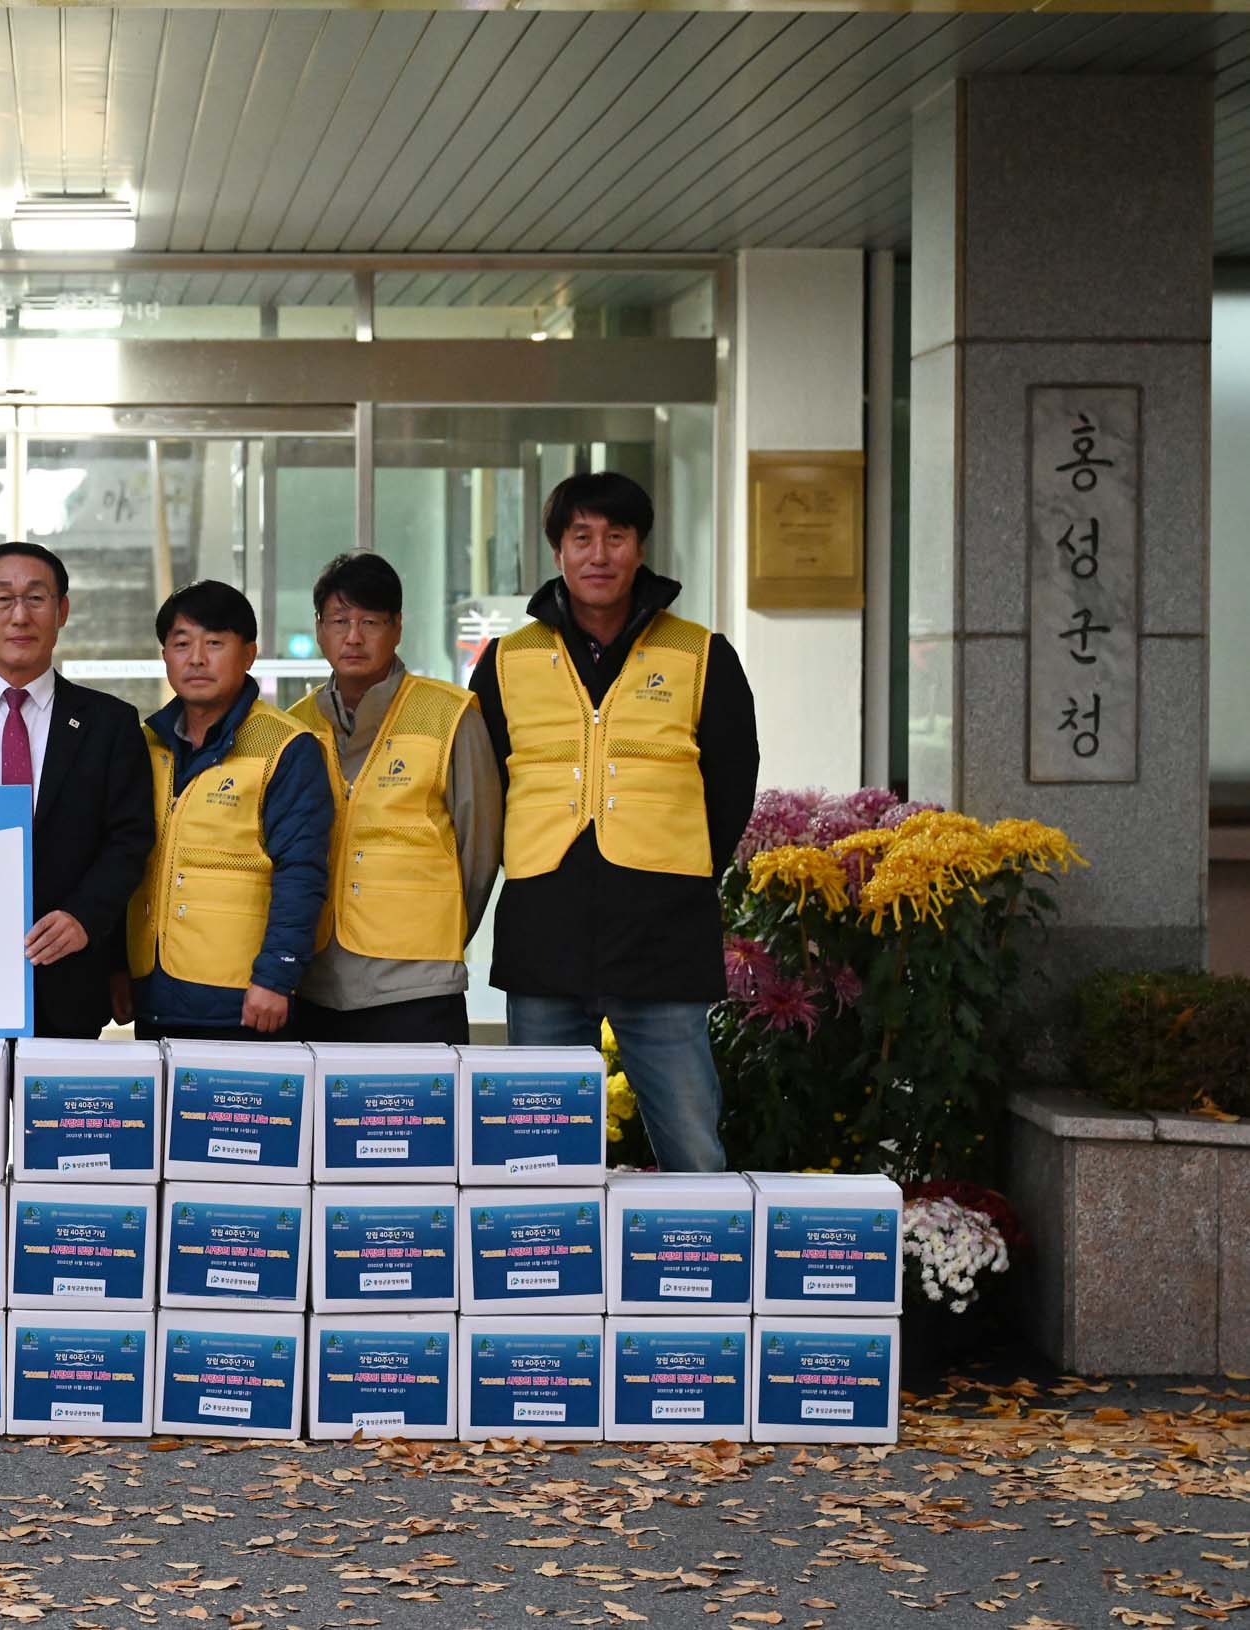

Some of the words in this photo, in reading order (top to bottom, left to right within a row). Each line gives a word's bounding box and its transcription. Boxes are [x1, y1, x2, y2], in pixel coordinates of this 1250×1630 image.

[1055, 413, 1114, 757] 홍성군청
[211, 1095, 225, 1104] 창립
[225, 1096, 247, 1105] 40주년
[248, 1097, 262, 1106] 기념
[365, 1099, 378, 1108] 창립
[378, 1099, 400, 1107] 40주년
[401, 1098, 414, 1107] 기념
[205, 1112, 232, 1123] 사랑의
[56, 1227, 70, 1236] 창립
[70, 1228, 92, 1237] 40주년
[92, 1229, 106, 1237] 기념
[365, 1231, 379, 1240] 창립
[379, 1231, 401, 1240] 40주년
[402, 1231, 415, 1239] 기념
[806, 1233, 820, 1241] 창립
[820, 1233, 842, 1242] 40주년
[843, 1233, 856, 1242] 기념
[361, 1248, 387, 1259] 사랑의
[801, 1250, 828, 1260] 사랑의
[205, 1356, 219, 1365] 창립
[219, 1357, 242, 1367] 40주년
[242, 1358, 256, 1367] 기념
[655, 1356, 669, 1365] 창립
[669, 1356, 691, 1365] 40주년
[692, 1356, 705, 1365] 기념
[799, 1357, 813, 1366] 창립
[813, 1358, 835, 1366] 40주년
[835, 1358, 849, 1367] 기념
[650, 1373, 677, 1384] 사랑의
